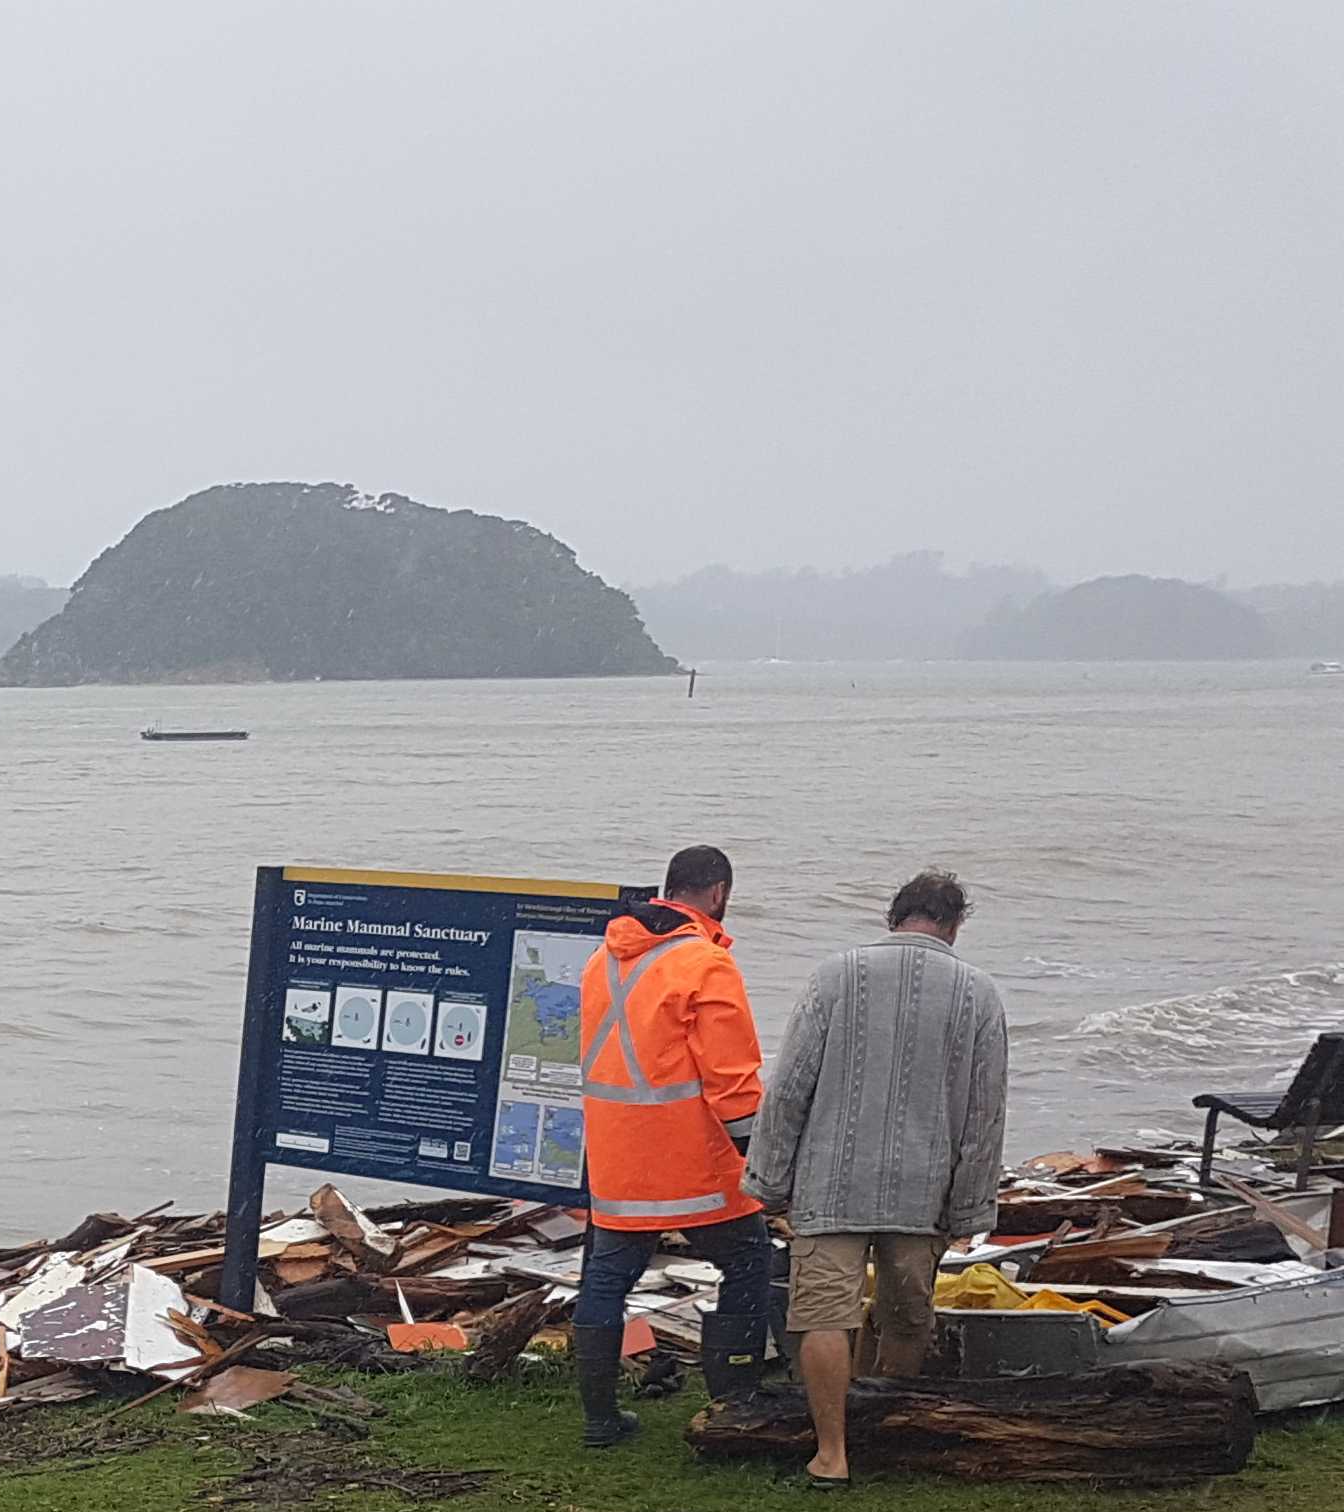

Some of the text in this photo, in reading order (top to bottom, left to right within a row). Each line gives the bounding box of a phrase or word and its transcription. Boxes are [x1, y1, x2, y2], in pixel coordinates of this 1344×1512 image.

[292, 916, 491, 946] Marine Mammal Sanctuary
[290, 941, 441, 960] All marine mammals are protected.
[288, 954, 471, 976] It is your responsibility to know the rules.
